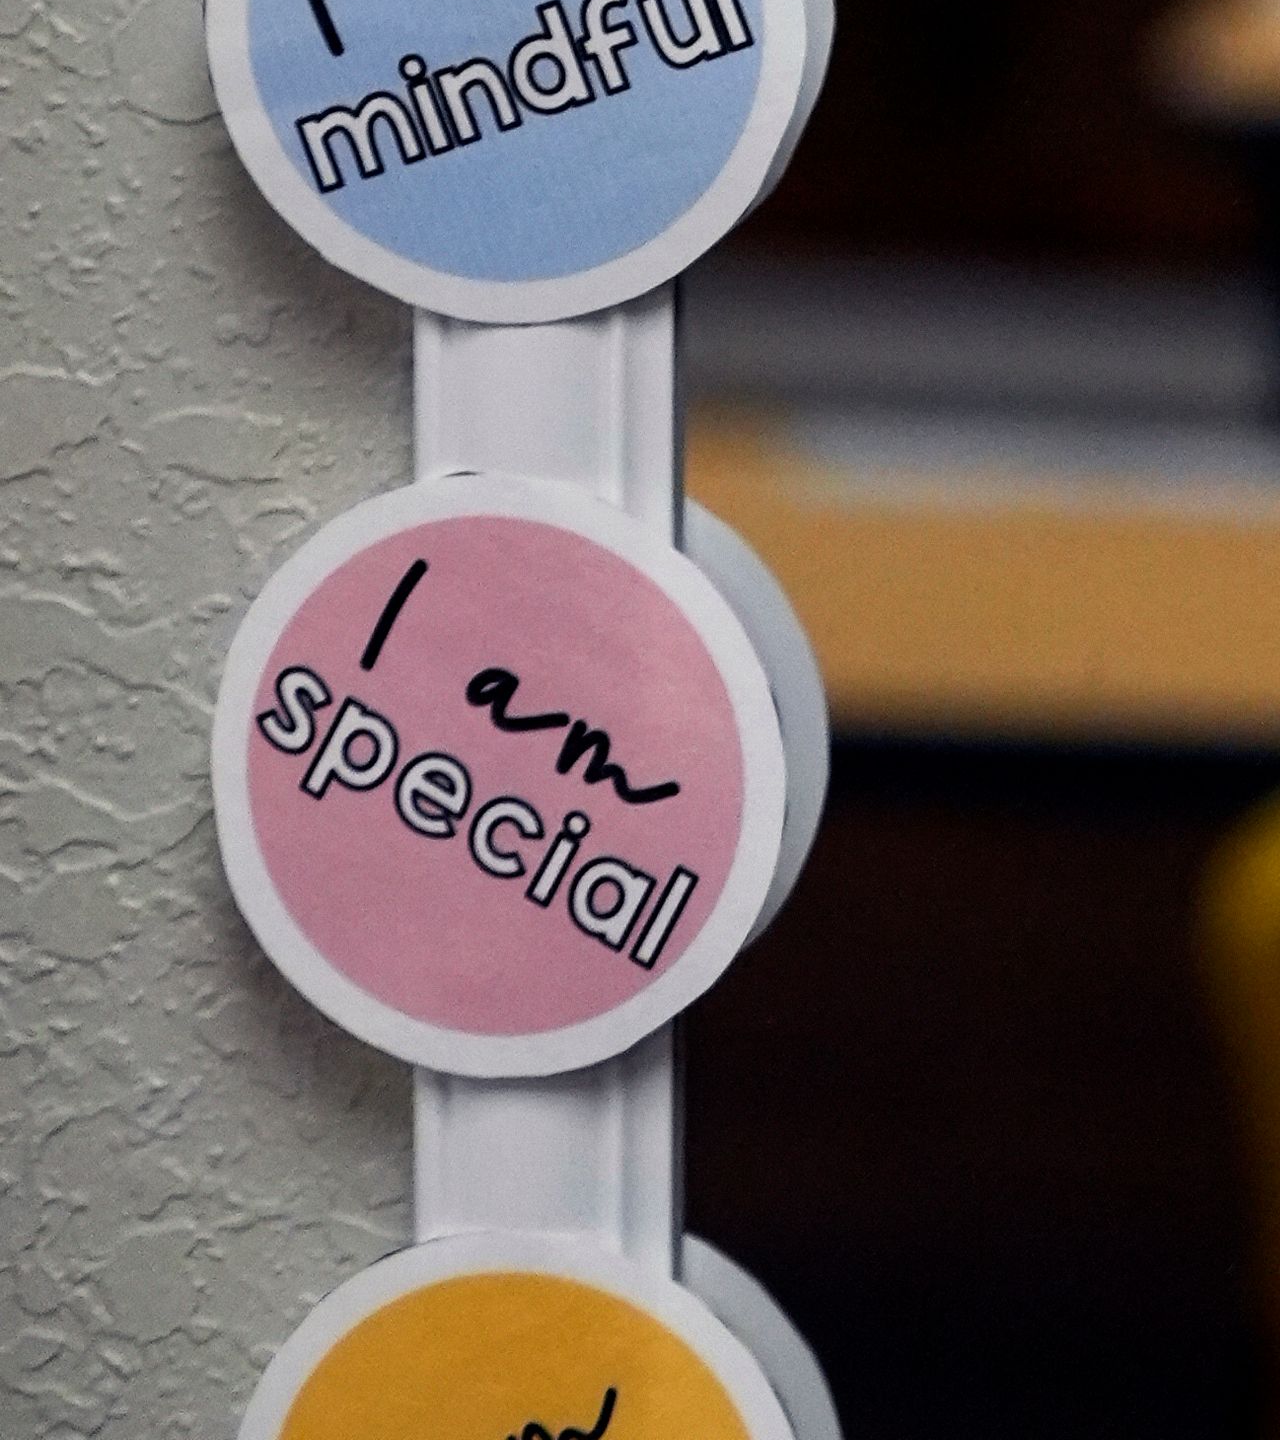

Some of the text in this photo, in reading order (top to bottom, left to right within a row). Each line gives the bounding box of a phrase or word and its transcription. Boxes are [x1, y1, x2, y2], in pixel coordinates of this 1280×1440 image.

[256, 666, 699, 971] special
[360, 559, 680, 804] I am
